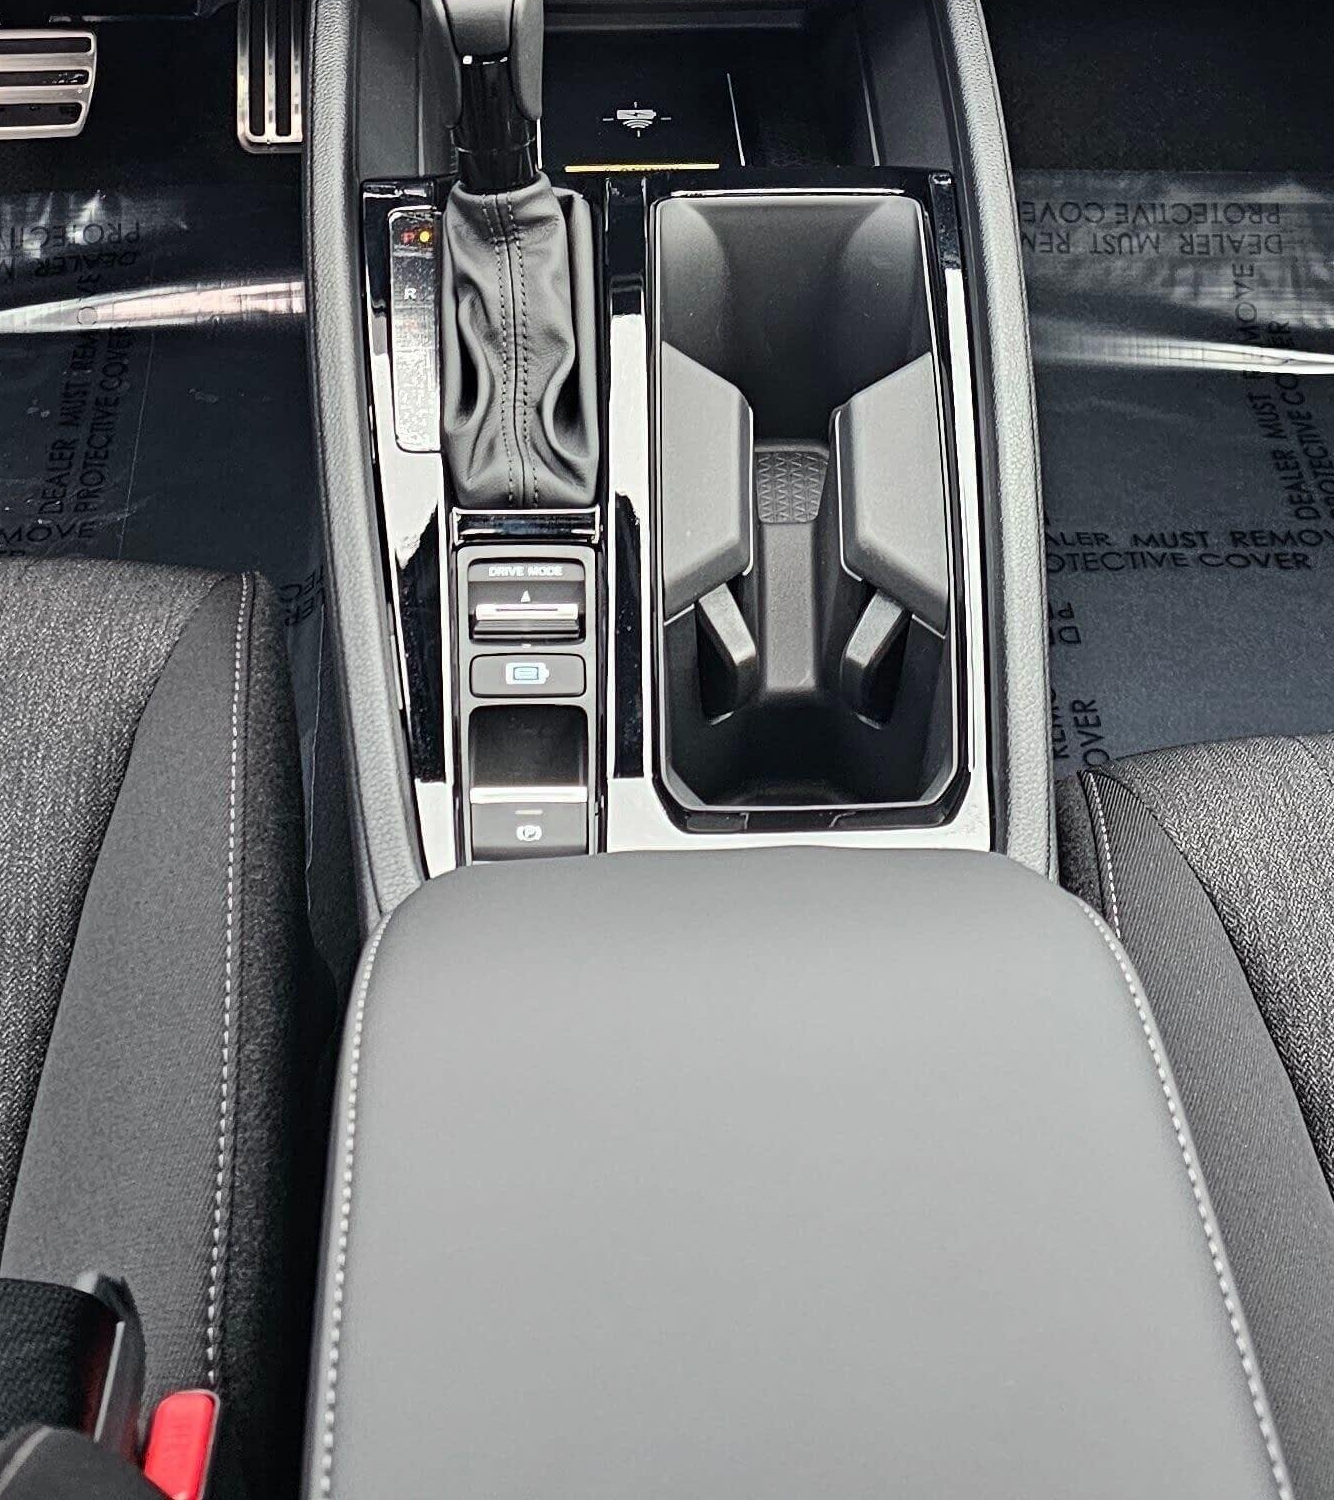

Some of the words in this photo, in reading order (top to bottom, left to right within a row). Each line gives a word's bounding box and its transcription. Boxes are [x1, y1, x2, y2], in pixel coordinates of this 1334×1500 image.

[1114, 202, 1280, 225] PROTECTIVE
[1091, 232, 1159, 255] MUST
[1180, 233, 1282, 255] DEALER
[404, 286, 417, 300] R
[1270, 450, 1322, 521] DEALER
[1130, 530, 1210, 549] MUST
[488, 566, 524, 577] DRIVE
[527, 566, 563, 577] MODE
[1198, 551, 1312, 571] COVER
